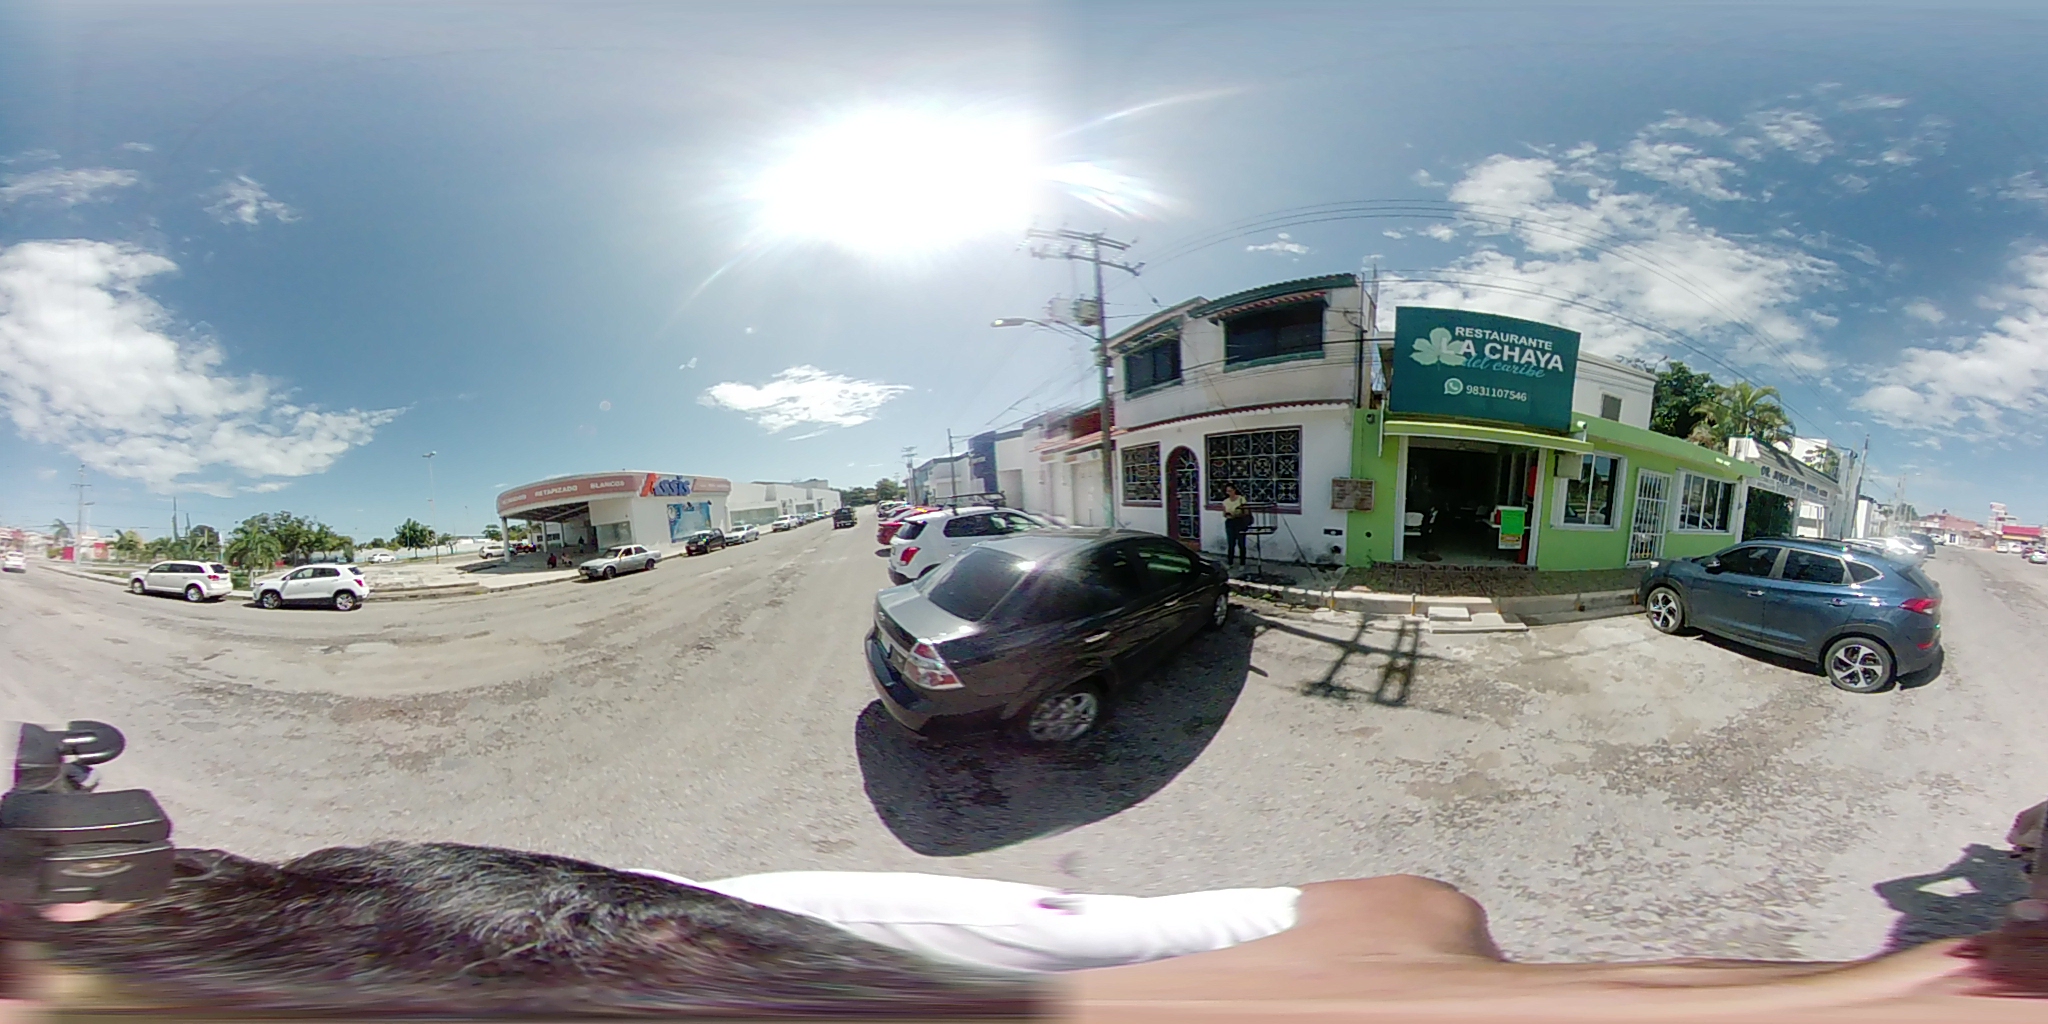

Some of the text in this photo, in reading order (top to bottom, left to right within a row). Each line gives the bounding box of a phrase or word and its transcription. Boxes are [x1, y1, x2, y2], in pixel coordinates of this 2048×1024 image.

[1455, 326, 1553, 351] RESTAURANTE
[1441, 337, 1564, 373] LA CHAYA
[1462, 352, 1546, 378] del caribe
[1466, 384, 1527, 402] 9831107546
[590, 480, 625, 490] BLANCOS
